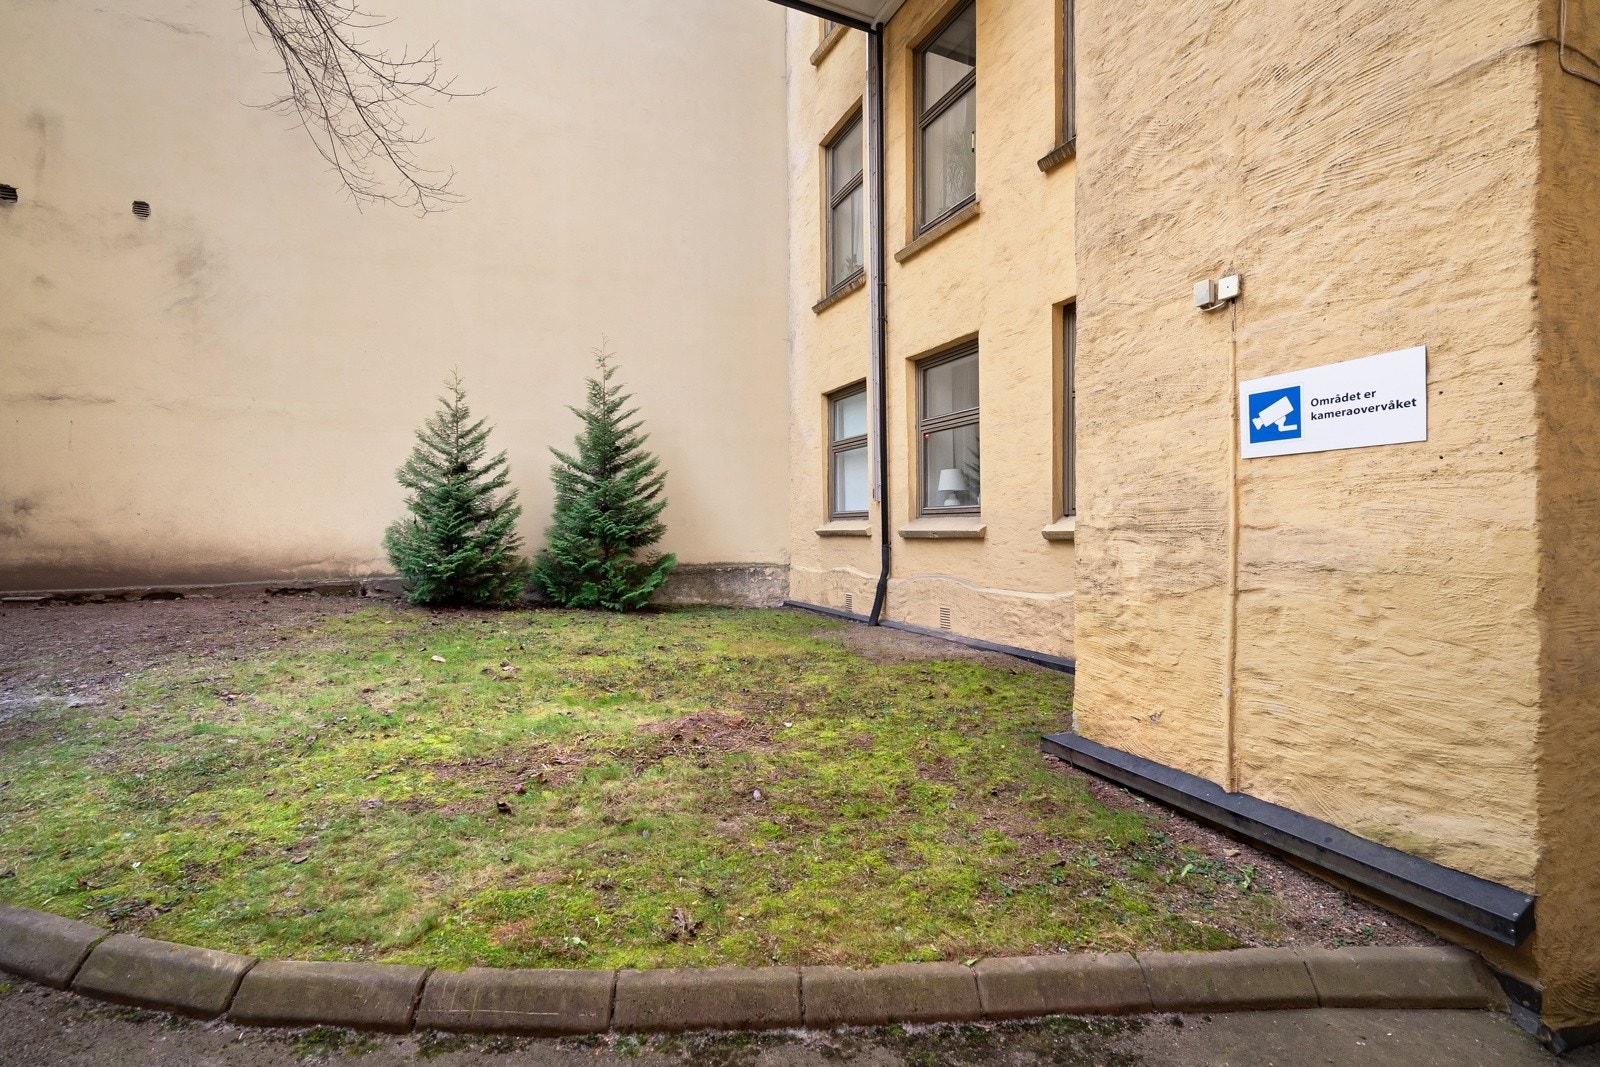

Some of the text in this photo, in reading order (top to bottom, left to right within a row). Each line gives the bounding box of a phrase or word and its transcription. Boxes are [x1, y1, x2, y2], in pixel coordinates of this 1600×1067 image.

[1310, 389, 1377, 407] Området er
[1310, 398, 1417, 421] kameraovervåket
